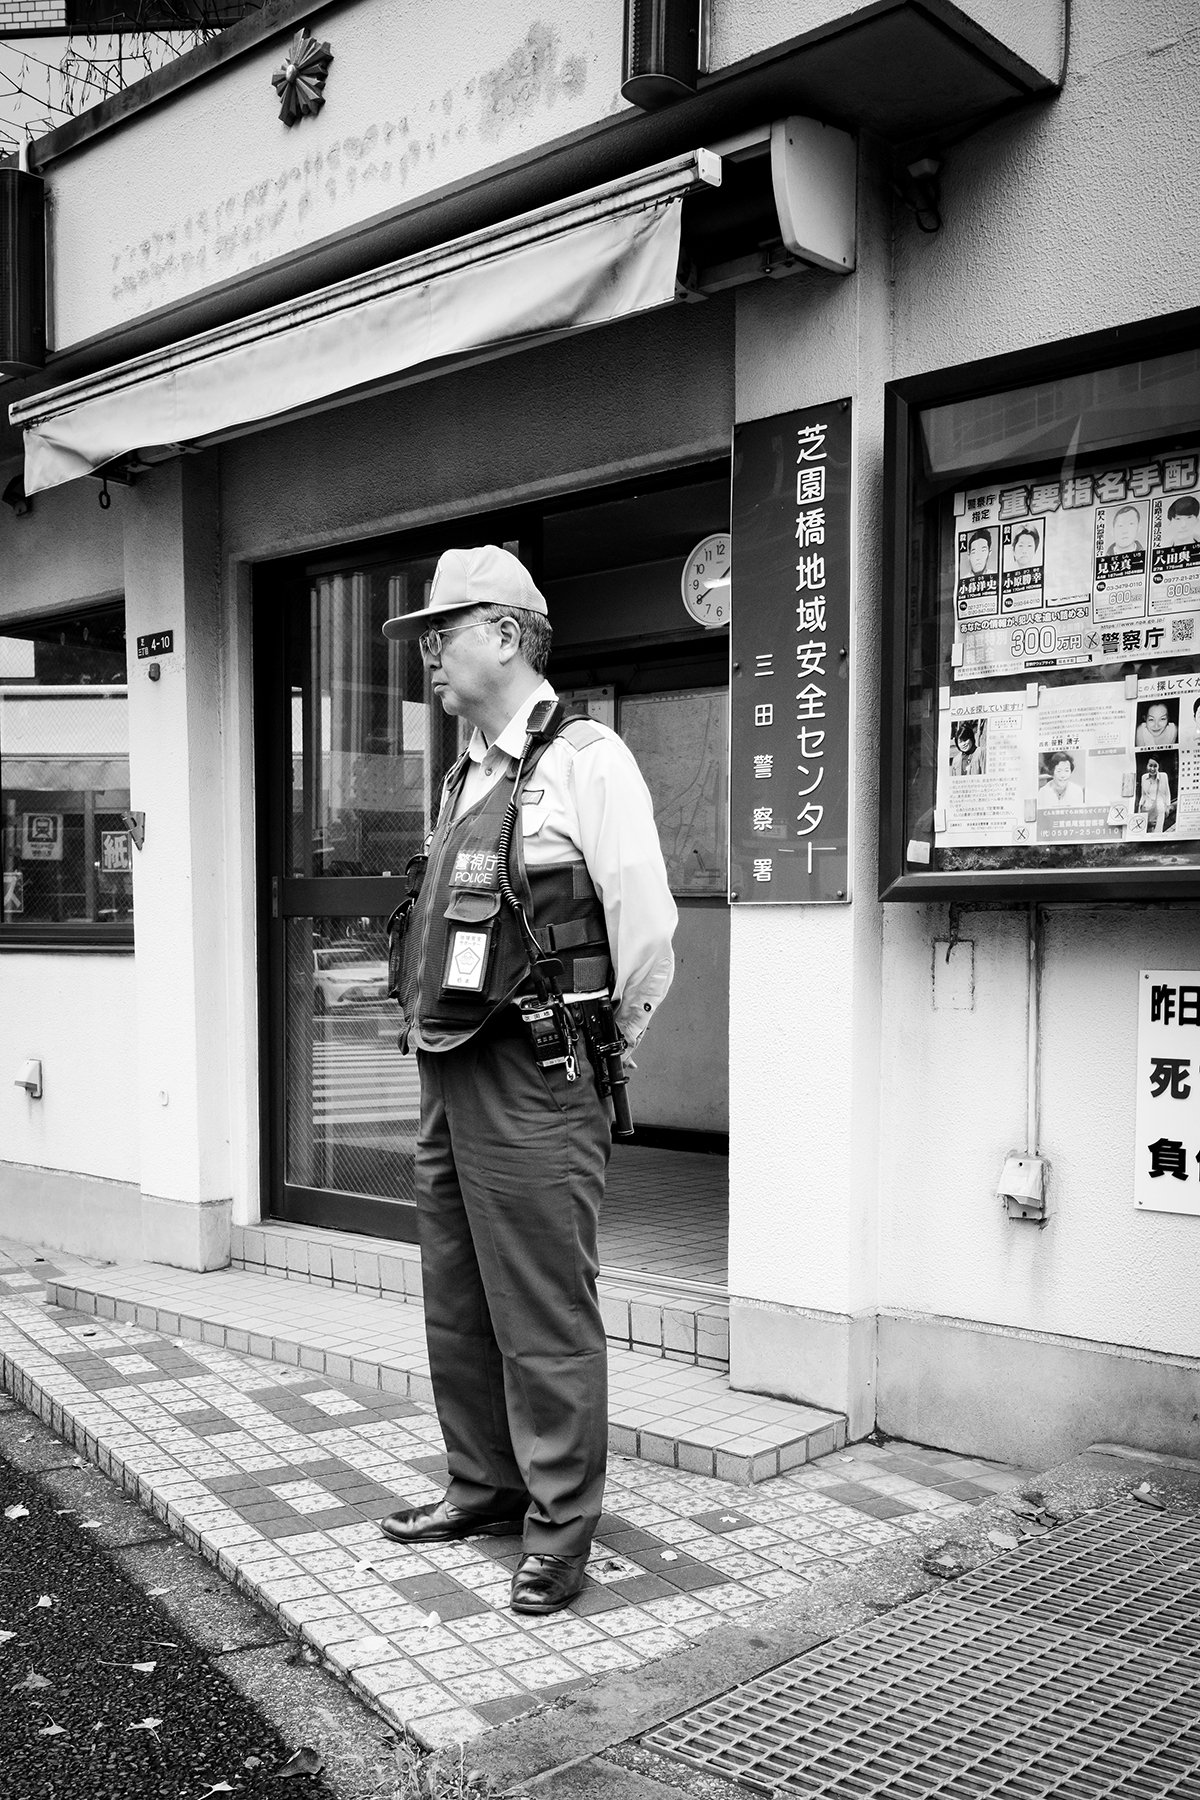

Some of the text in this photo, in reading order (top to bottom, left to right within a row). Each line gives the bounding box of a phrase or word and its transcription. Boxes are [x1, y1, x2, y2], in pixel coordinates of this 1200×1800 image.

[998, 455, 1198, 521] 重要指名手配
[967, 494, 996, 510] 警察庁
[972, 509, 990, 522] 指定
[705, 550, 712, 561] 11
[716, 543, 725, 555] 12
[696, 563, 705, 574] 10
[1097, 559, 1143, 575] 見立真一
[693, 579, 699, 590] 9
[705, 603, 711, 614] 7
[716, 606, 722, 617] 6
[151, 635, 170, 651] 4-10
[796, 423, 828, 874] 芝園橋地域安全センター
[1011, 625, 1082, 657] 300万円
[1101, 627, 1164, 654] 警察庁
[753, 654, 774, 883] 三田警察署
[103, 835, 128, 869] 紙
[456, 853, 499, 871] 警視庁
[455, 871, 493, 885] POLICE
[1151, 984, 1200, 1026] 昨日
[1149, 1058, 1200, 1100] 死
[1148, 1138, 1200, 1181] 負
